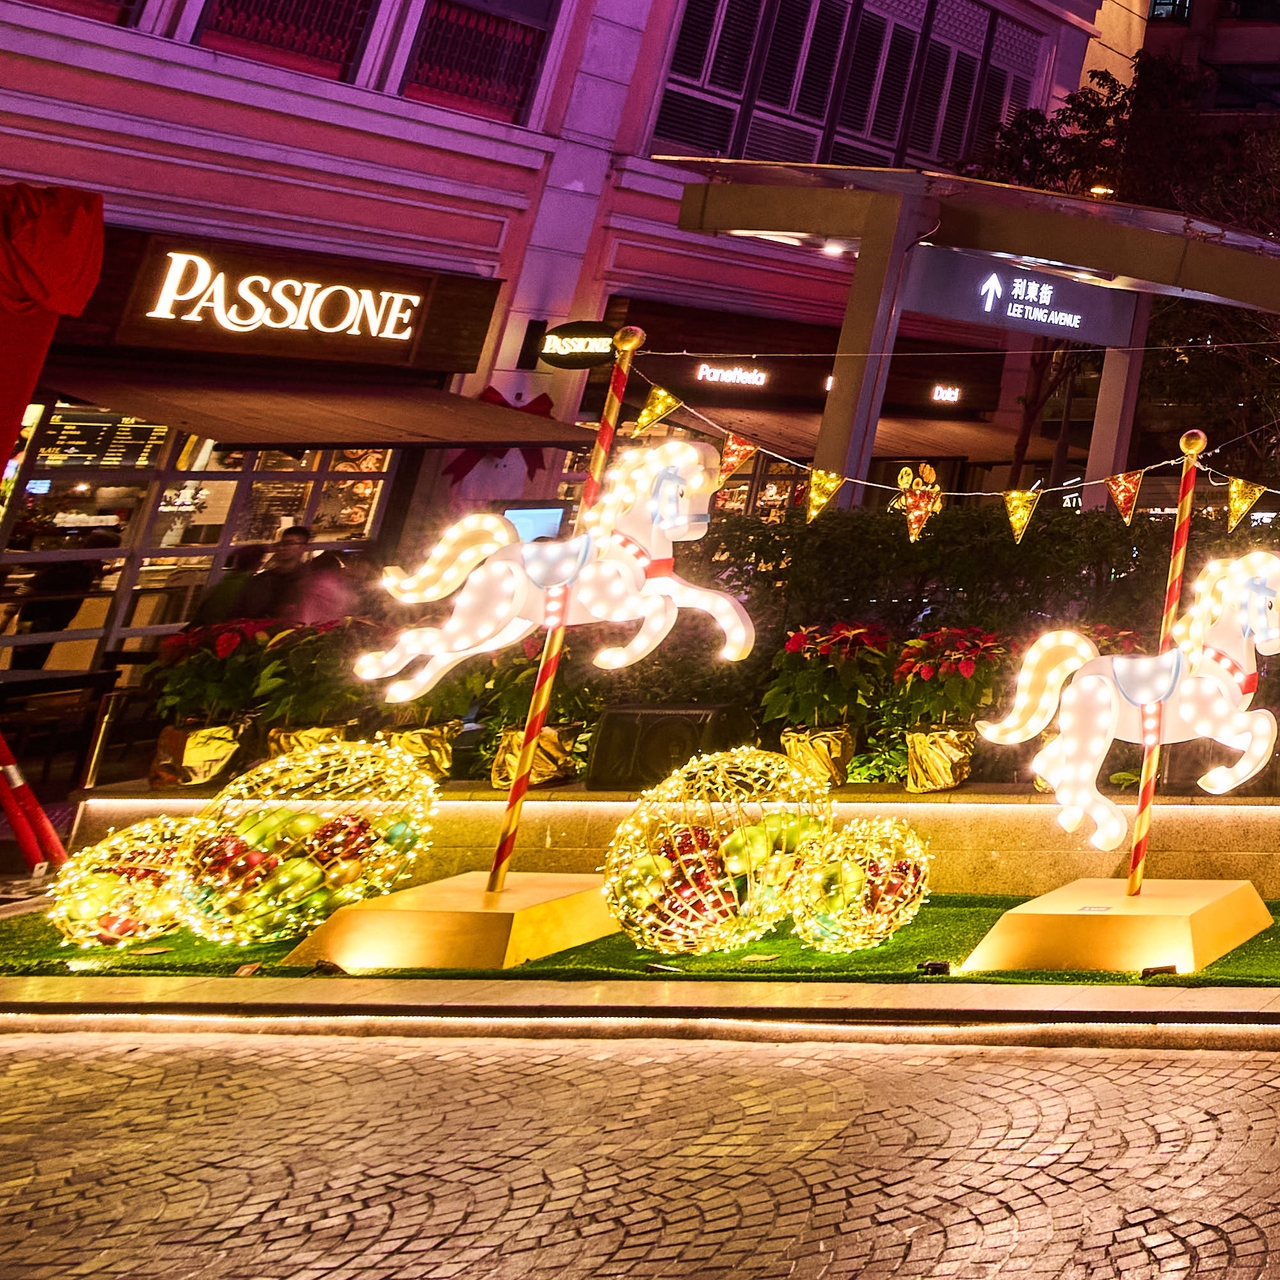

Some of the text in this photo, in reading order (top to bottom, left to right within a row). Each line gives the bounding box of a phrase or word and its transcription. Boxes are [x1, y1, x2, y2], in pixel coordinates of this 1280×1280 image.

[145, 251, 421, 341] PASSIONE
[1011, 278, 1053, 305] 利東街
[1007, 303, 1081, 328] LEE TUNG AVENUE
[697, 363, 767, 386] Panetteria
[933, 385, 960, 402] Dolci
